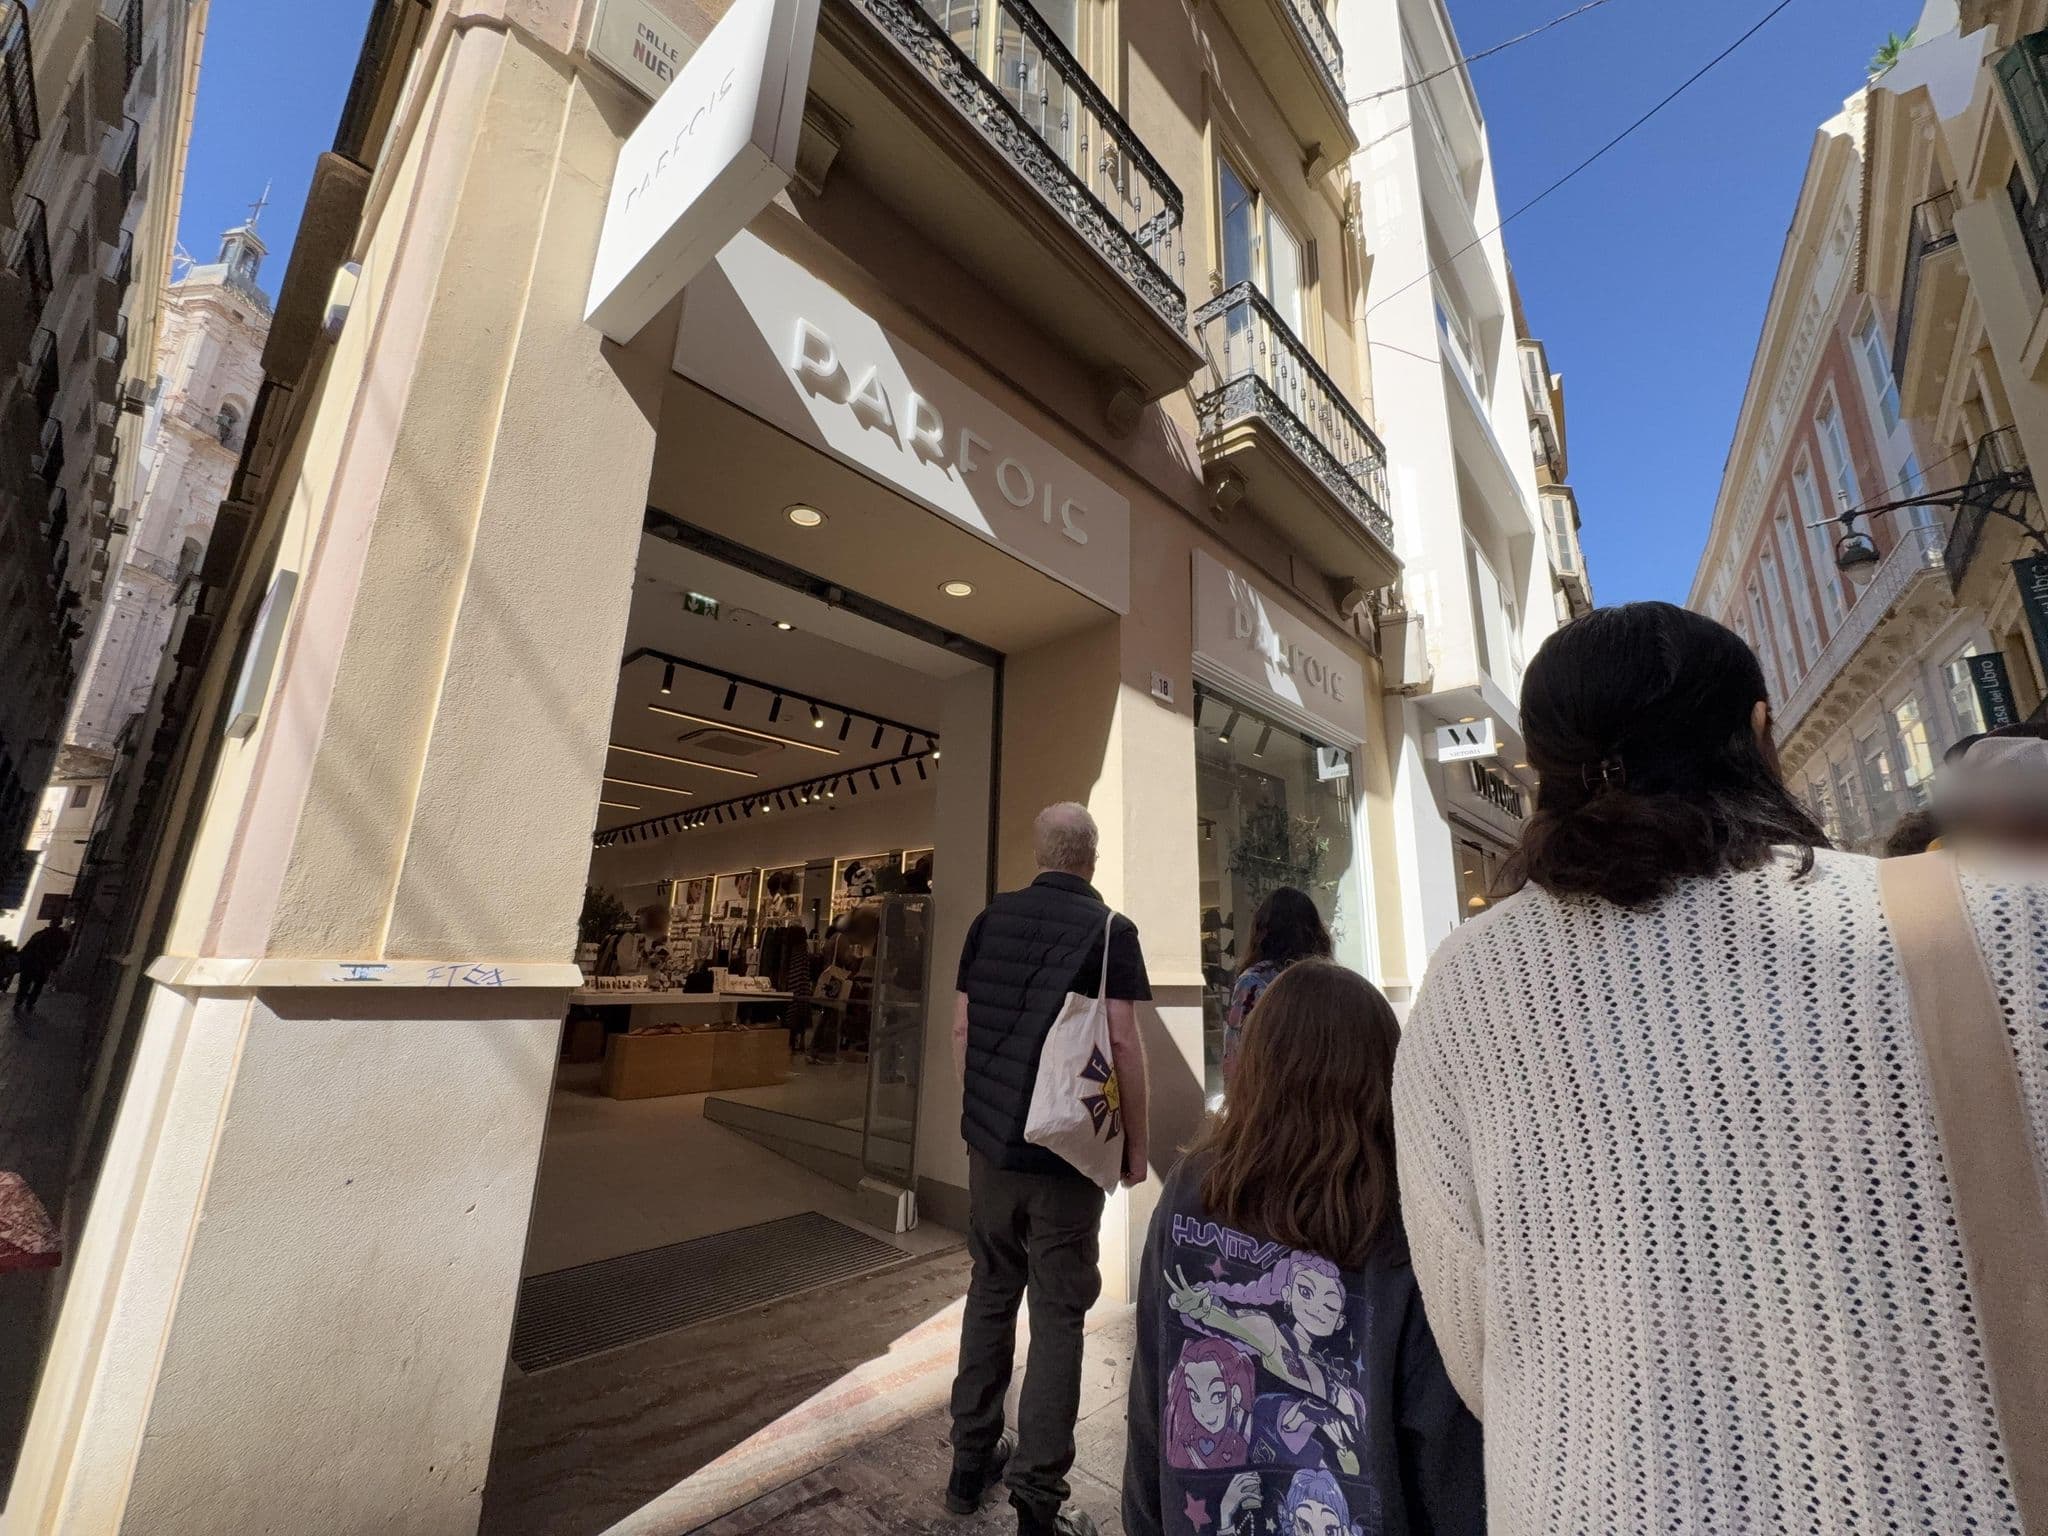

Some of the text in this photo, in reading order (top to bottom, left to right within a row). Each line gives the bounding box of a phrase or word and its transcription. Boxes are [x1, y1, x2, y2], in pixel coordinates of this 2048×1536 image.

[637, 22, 679, 62] CALLE
[790, 316, 1088, 546] PARFOIS
[1158, 678, 1169, 697] 18
[1980, 660, 2000, 689] Libro
[1988, 690, 2004, 703] del
